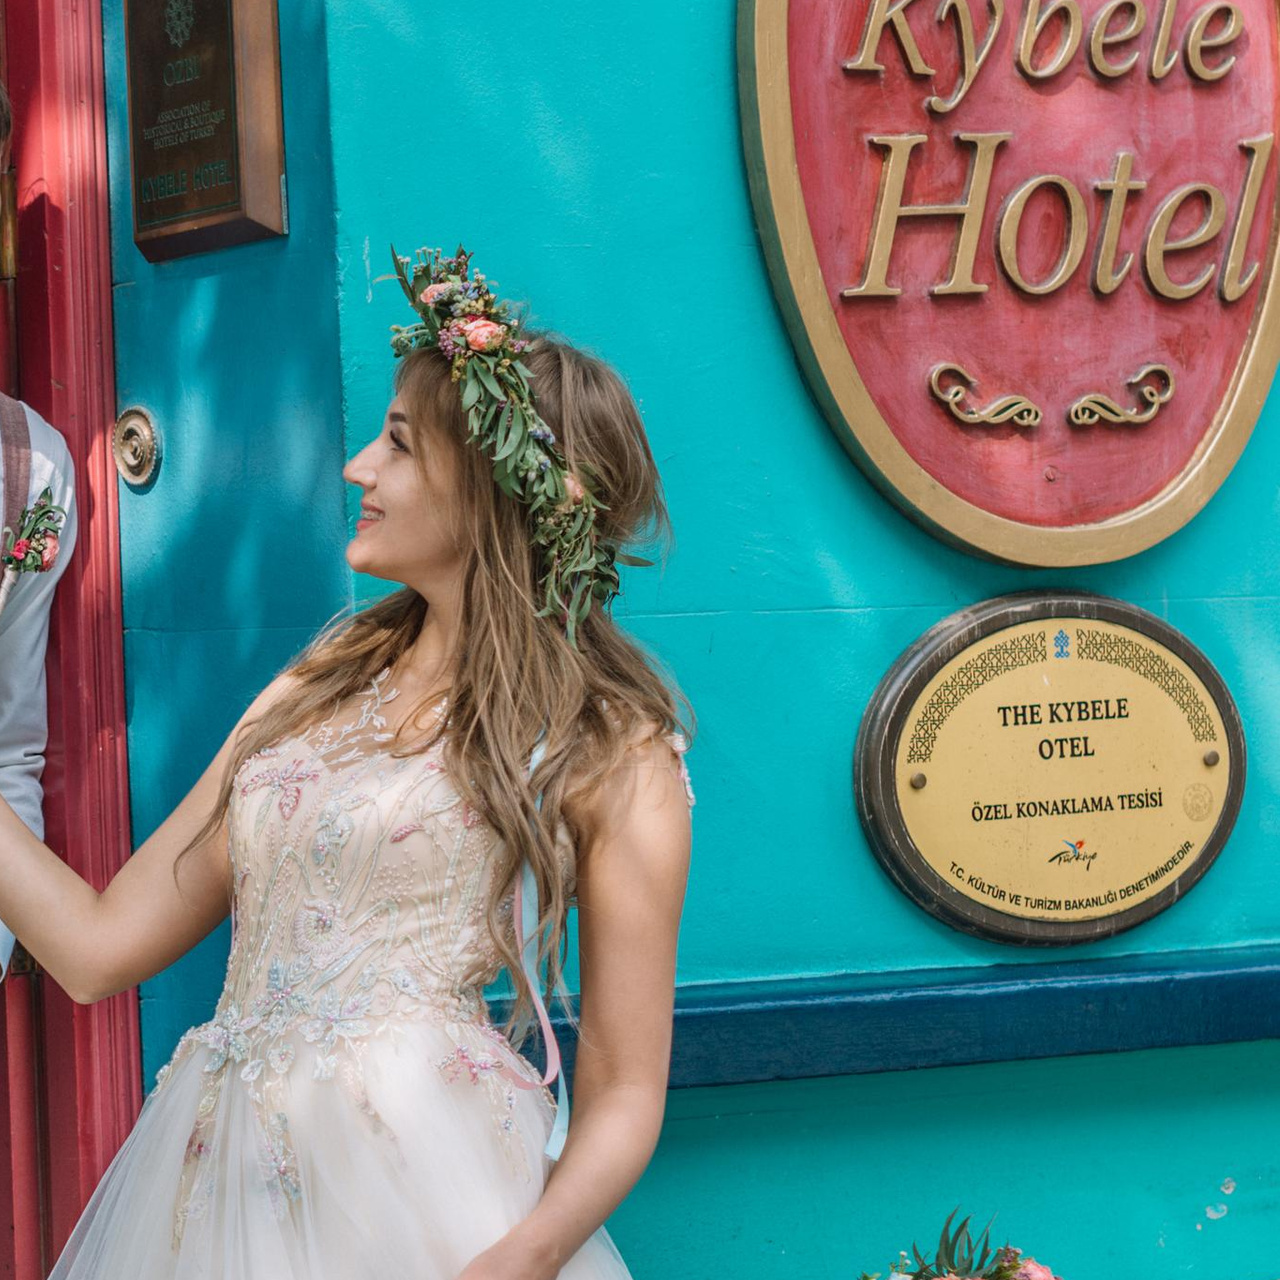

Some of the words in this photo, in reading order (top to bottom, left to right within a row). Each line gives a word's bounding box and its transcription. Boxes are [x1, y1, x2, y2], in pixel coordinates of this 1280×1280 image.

[143, 120, 182, 140] HISTORICAL
[190, 108, 226, 128] BOUTIQUE
[157, 102, 201, 123] ASSOCIATION
[202, 100, 212, 112] OF
[153, 133, 178, 150] HOTELS
[190, 123, 216, 141] TURKEY
[142, 168, 188, 204] KYBELE
[193, 159, 233, 192] HOTEL
[841, 130, 1277, 304] Hotel
[997, 704, 1042, 727] THE
[1048, 698, 1130, 725] KYBELE
[1038, 736, 1096, 760] OTEL
[971, 800, 1013, 822] ÖZEL
[1016, 796, 1114, 818] KONAKLAMA
[1118, 787, 1164, 811] TESİSİ
[1047, 848, 1098, 872] Türkiye
[949, 861, 965, 881] T.C.
[967, 874, 1006, 902] KÜLTÜR
[1009, 893, 1022, 907] VE
[1024, 896, 1062, 911] TURİZM
[1064, 890, 1118, 911] BAKANLIĞI
